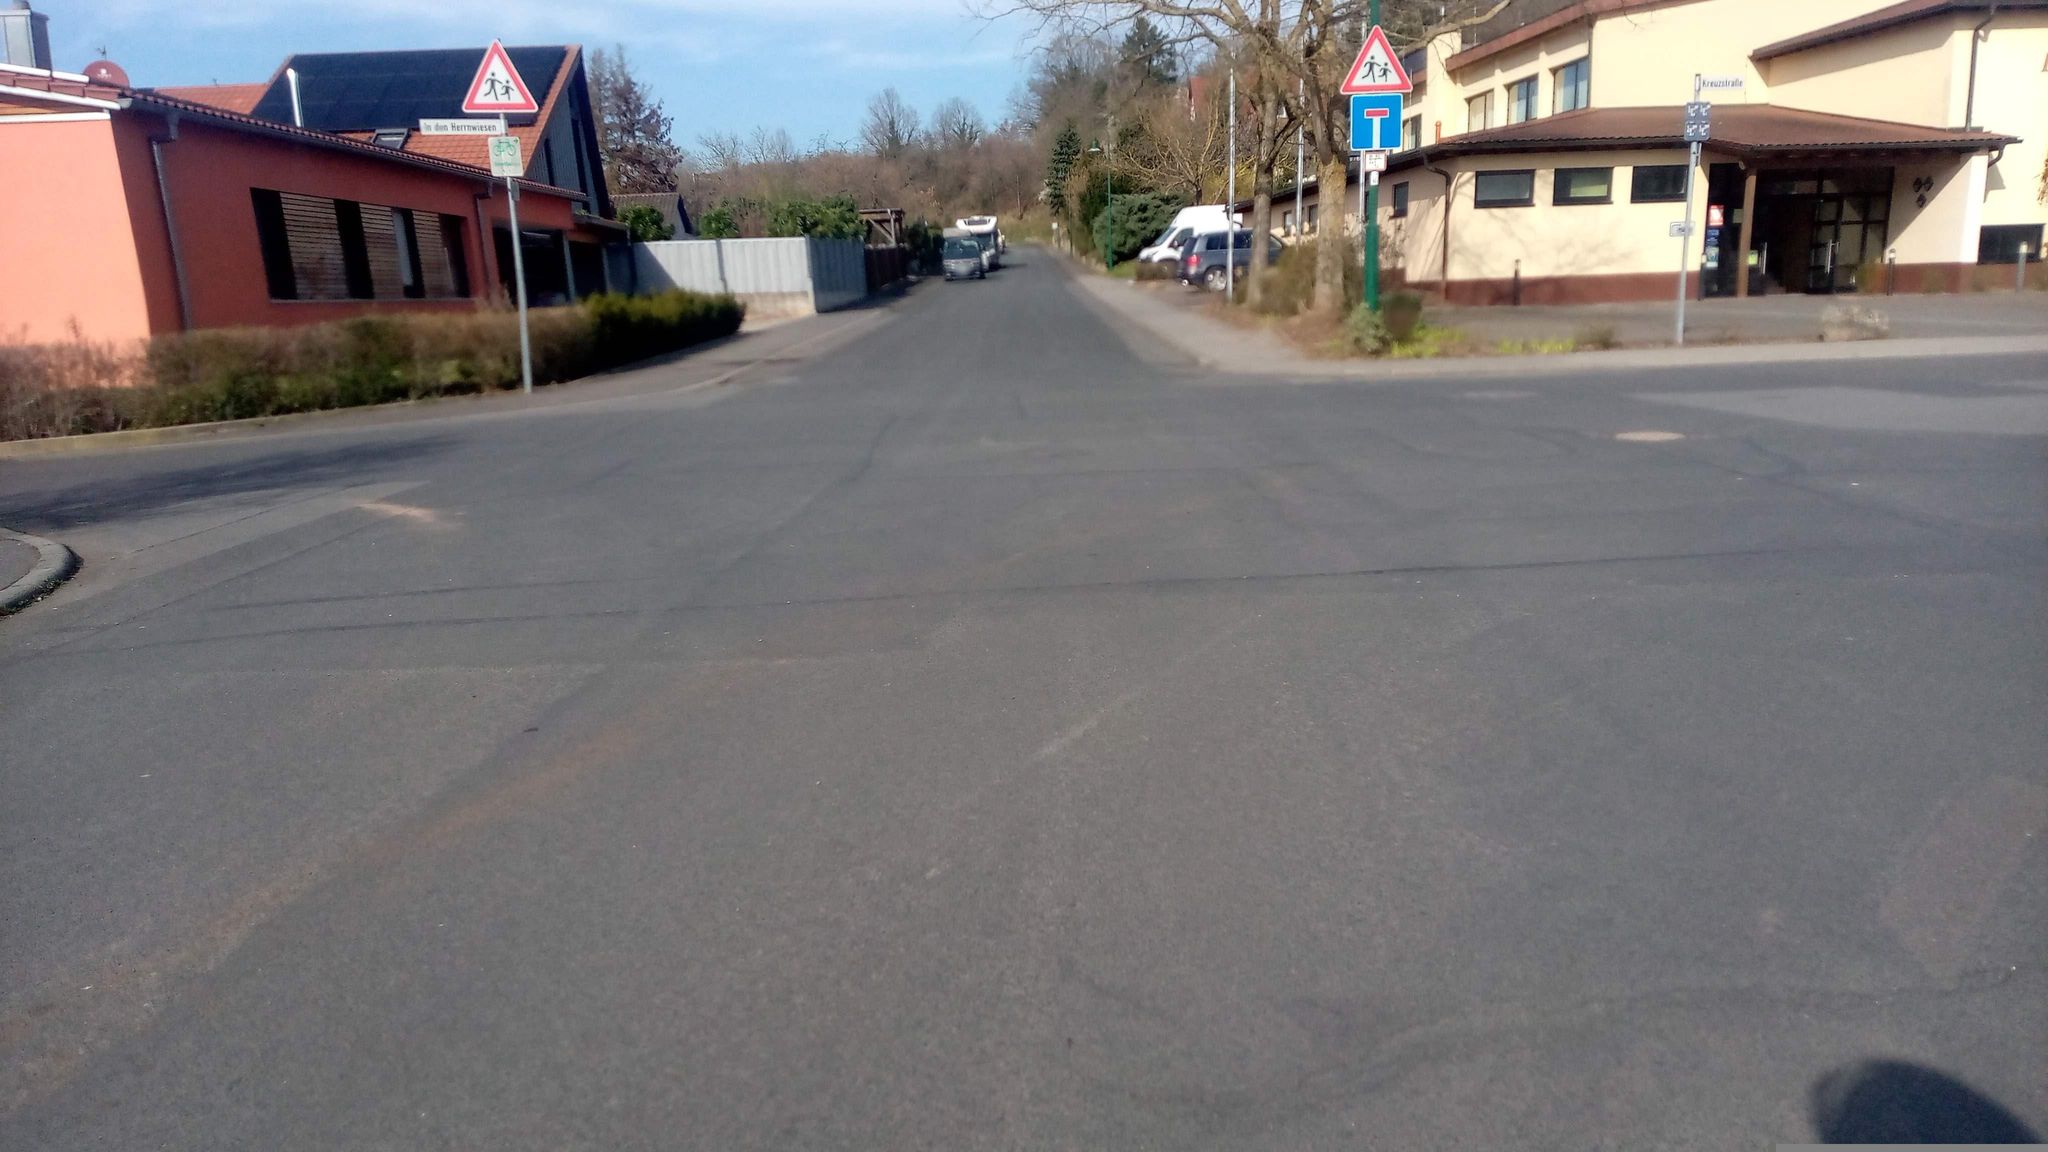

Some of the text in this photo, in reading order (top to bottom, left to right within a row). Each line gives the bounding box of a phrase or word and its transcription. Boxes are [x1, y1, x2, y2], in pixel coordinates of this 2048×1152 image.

[1702, 78, 1743, 88] Kreuzstraße
[424, 122, 497, 132] In den Herrnwiesen
